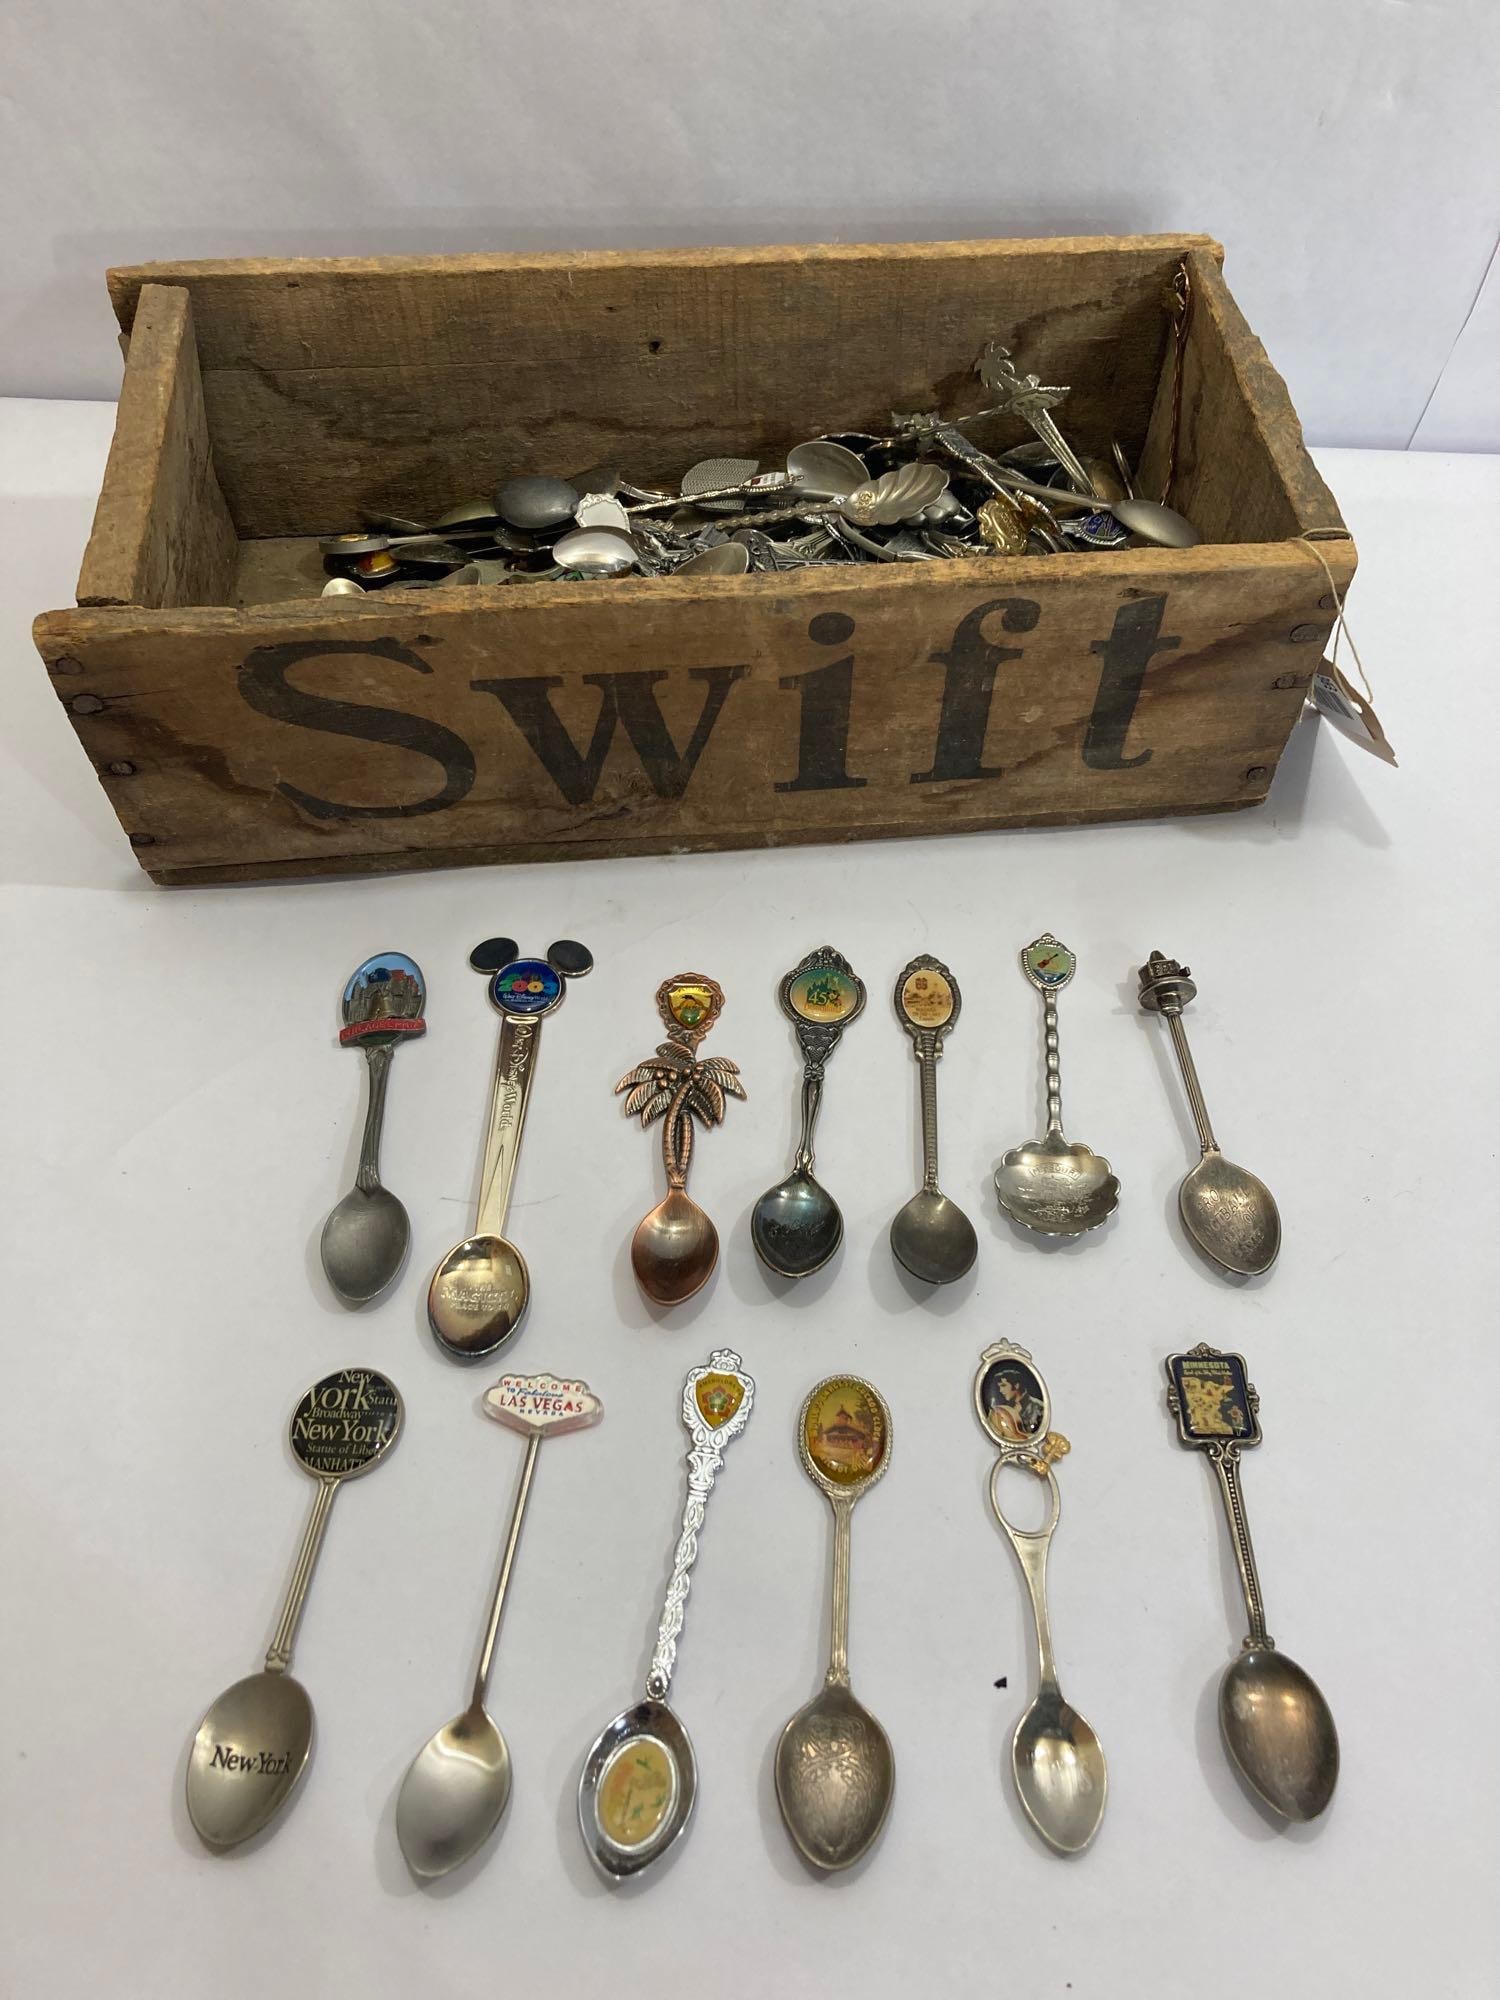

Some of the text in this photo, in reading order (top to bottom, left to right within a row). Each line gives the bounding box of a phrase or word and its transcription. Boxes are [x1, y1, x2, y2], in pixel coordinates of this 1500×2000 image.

[237, 592, 1181, 820] Swift
[338, 1370, 374, 1383] New
[503, 1380, 582, 1393] WELCOME
[500, 1395, 583, 1413] LAS VEGAS
[311, 1407, 362, 1420] Broadway
[519, 1408, 564, 1417] NEVADA
[292, 1418, 389, 1443] New York
[306, 1442, 337, 1454] Statue
[339, 1443, 351, 1455] of
[209, 1744, 290, 1775] New York
